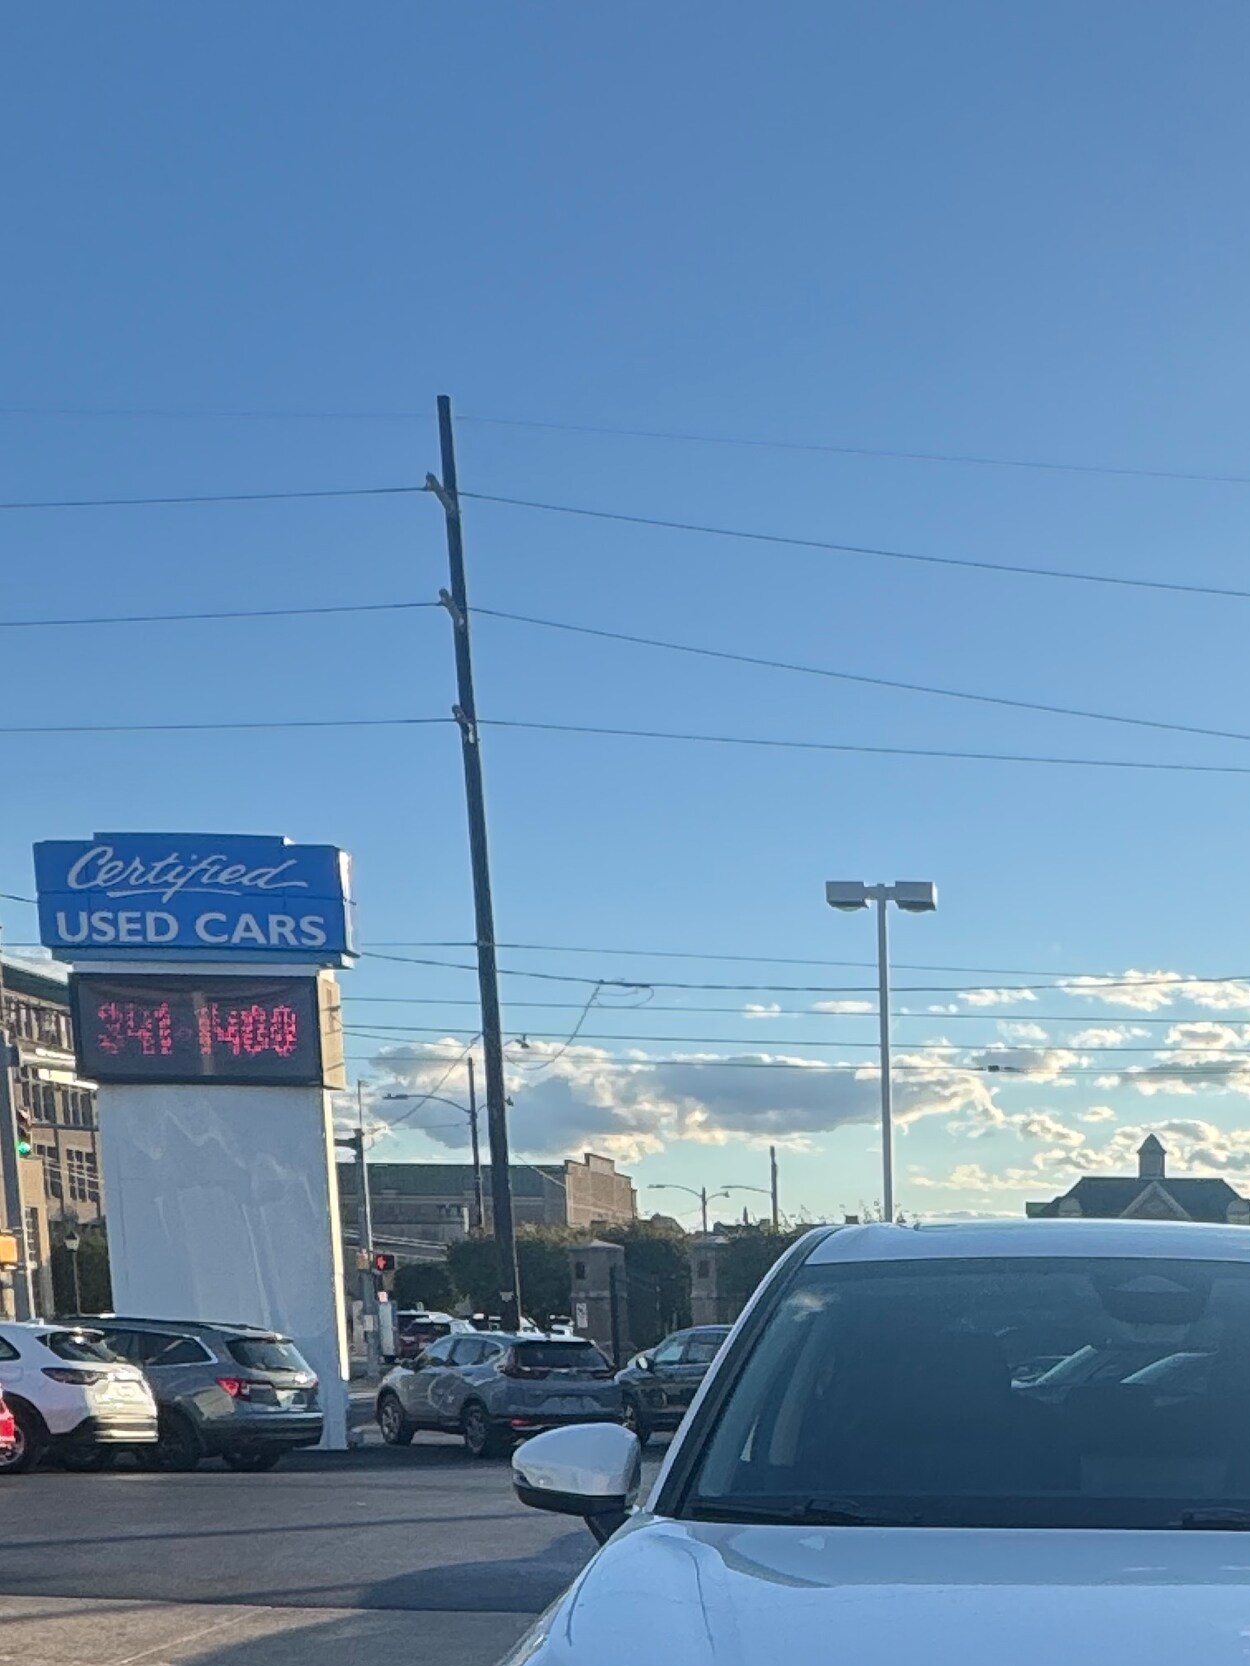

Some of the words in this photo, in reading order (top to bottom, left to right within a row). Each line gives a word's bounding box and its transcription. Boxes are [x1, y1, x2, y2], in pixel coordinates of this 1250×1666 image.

[67, 846, 309, 904] Certified
[56, 910, 180, 944] USED
[194, 911, 328, 947] CARS
